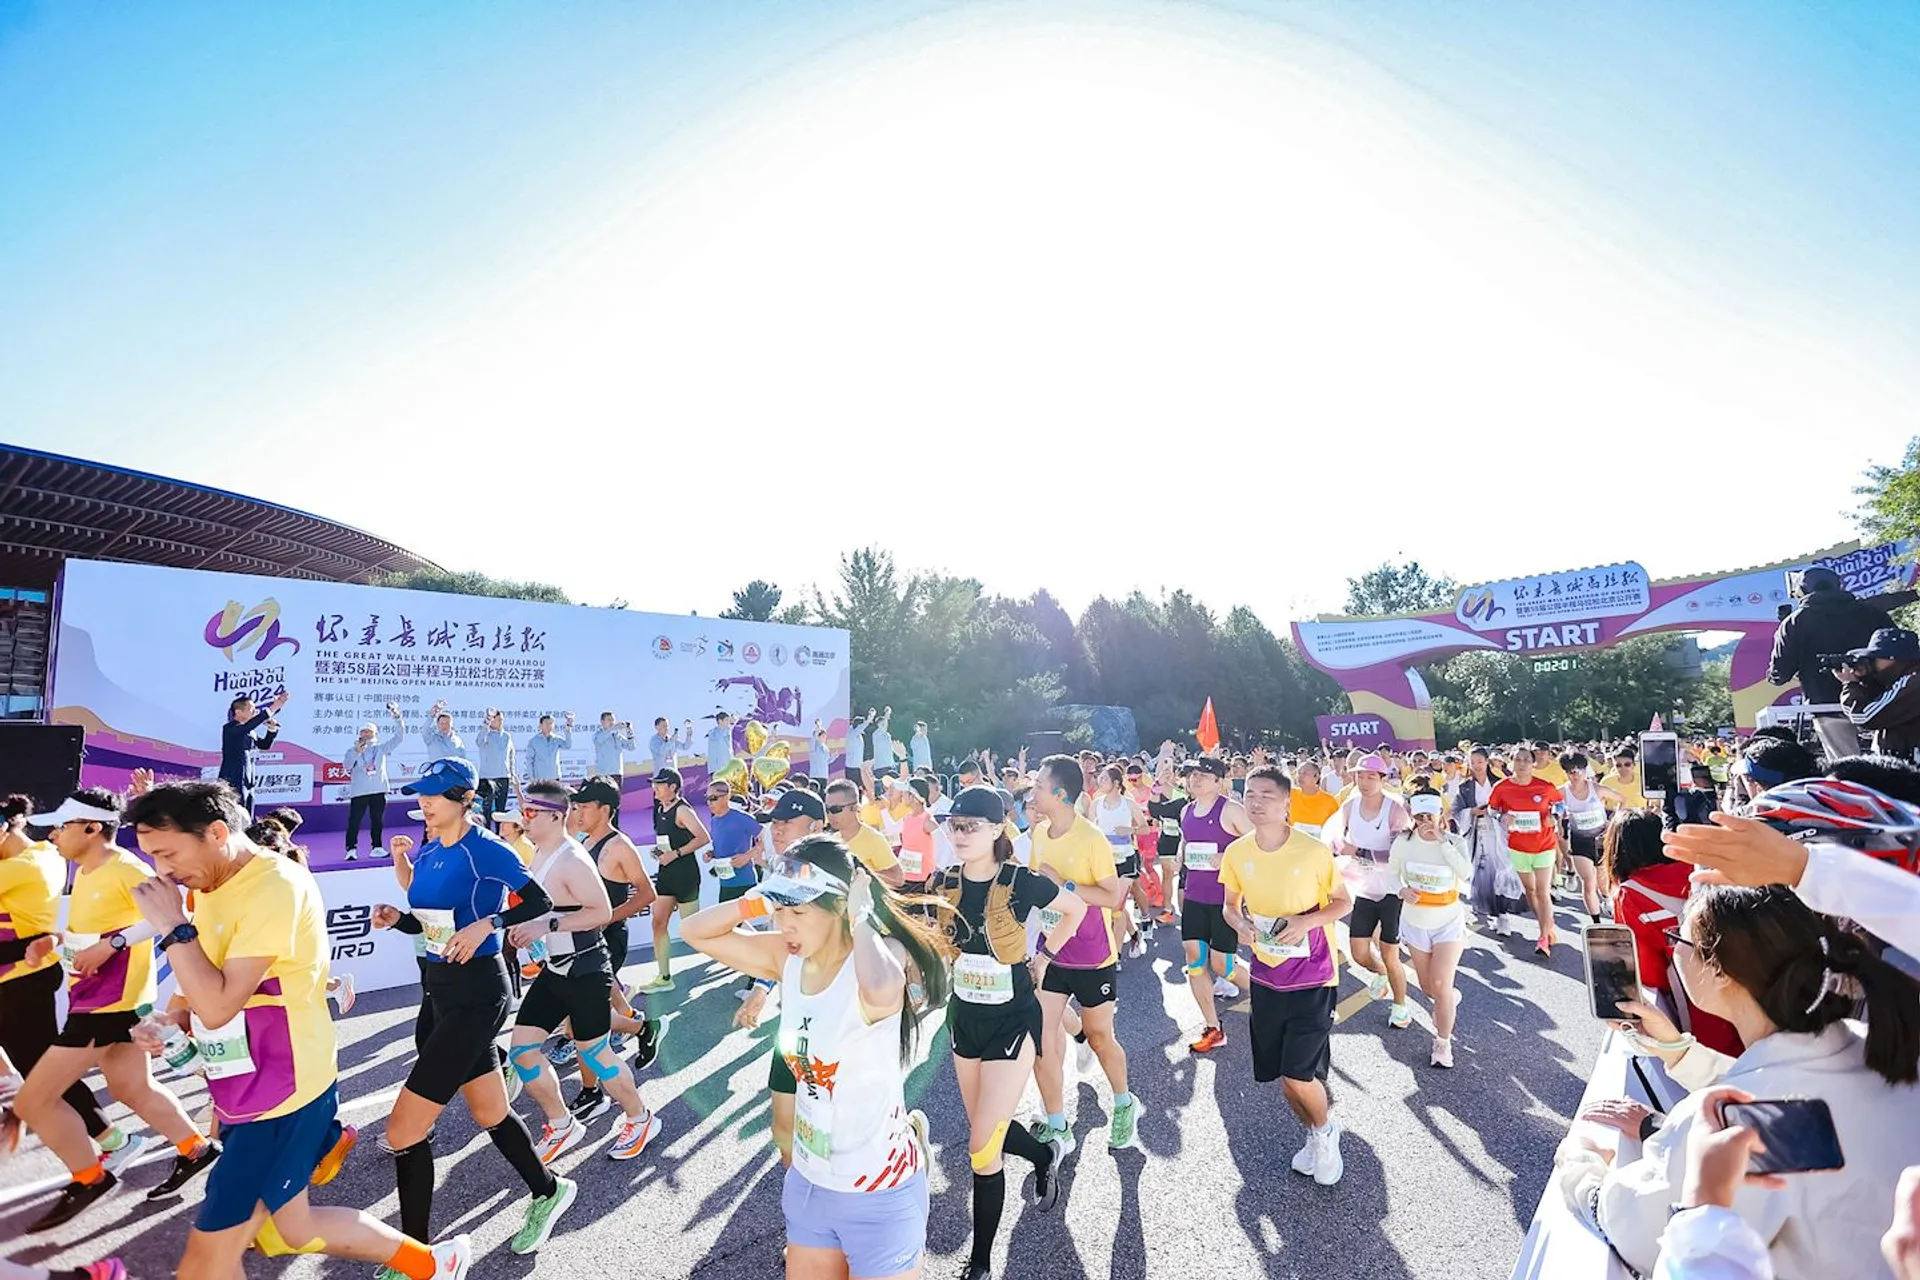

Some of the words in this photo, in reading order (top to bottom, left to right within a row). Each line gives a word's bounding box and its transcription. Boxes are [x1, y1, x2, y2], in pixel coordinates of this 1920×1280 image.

[1834, 543, 1894, 576] uaiRou
[1843, 561, 1901, 592] 2024
[1506, 622, 1599, 650] START
[316, 650, 339, 659] THE
[344, 651, 382, 660] GREAT
[386, 653, 416, 662] WALL
[421, 654, 481, 664] MARATHON
[501, 659, 546, 667] HUAIROU
[1533, 659, 1577, 673] 0:02:01
[315, 659, 545, 681] 暨第58届公园半程马拉松北京公开赛
[315, 676, 336, 684] THE
[361, 677, 399, 686] BEIJING
[401, 678, 426, 687] OPEN
[429, 679, 452, 687] HALF
[455, 680, 503, 689] MARATHON
[505, 681, 526, 689] PARK
[1330, 720, 1380, 736] START
[330, 941, 375, 961] IRD
